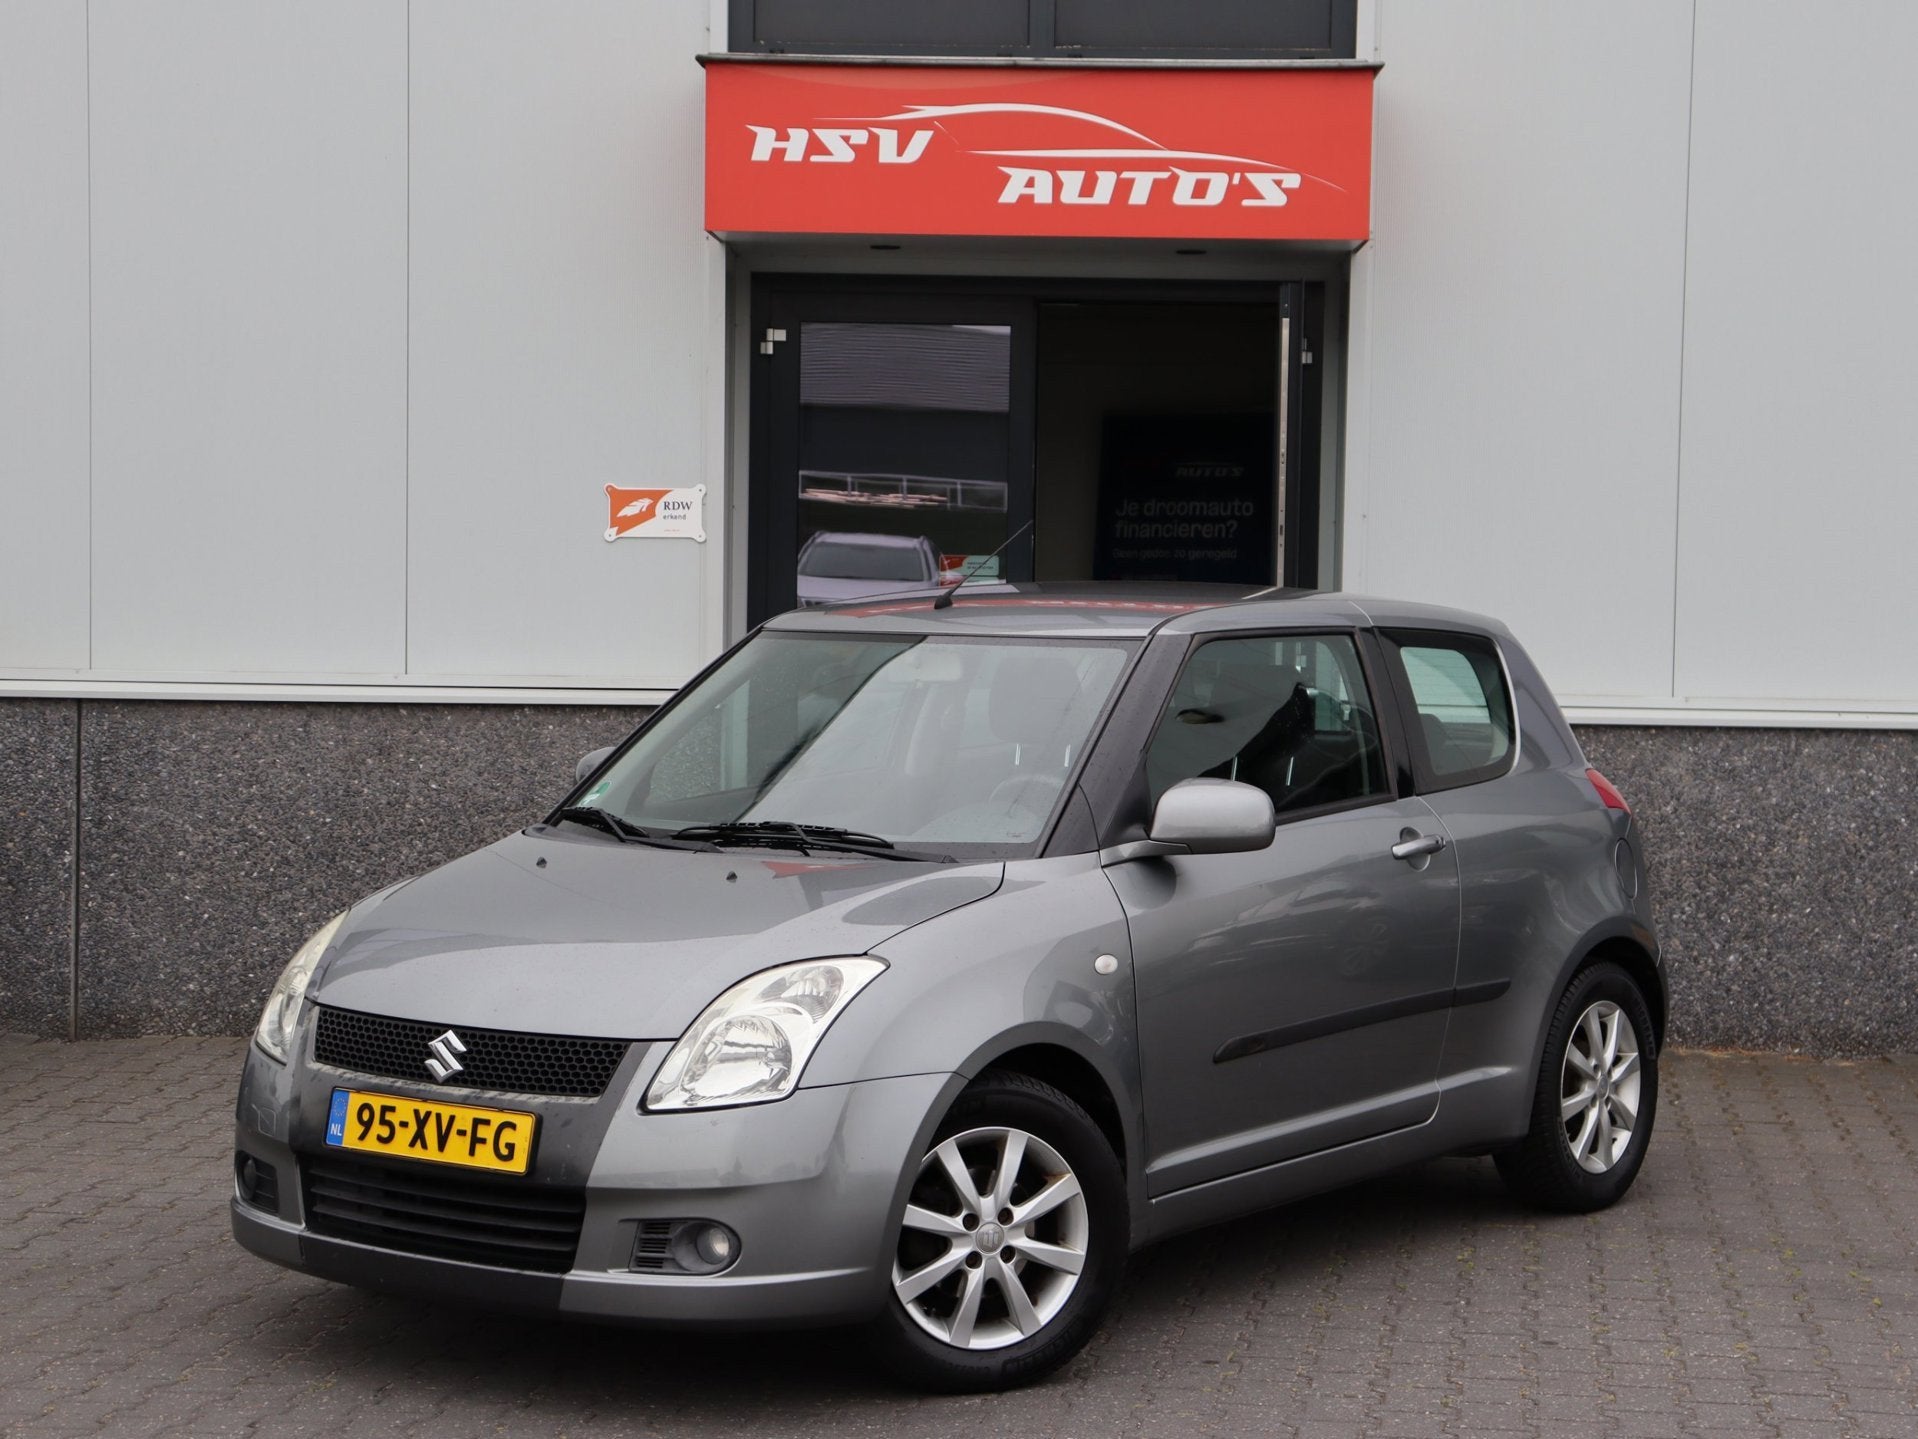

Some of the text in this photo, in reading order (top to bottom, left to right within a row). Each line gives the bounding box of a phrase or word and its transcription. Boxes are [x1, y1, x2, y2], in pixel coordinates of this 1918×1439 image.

[745, 124, 935, 164] HSV
[996, 165, 1302, 208] AUTO'S
[663, 500, 693, 511] RDW
[1115, 498, 1254, 516] Je droomauto
[1115, 519, 1238, 539] financieren?
[330, 1122, 343, 1137] NL
[355, 1101, 518, 1163] 95-XV-FG
